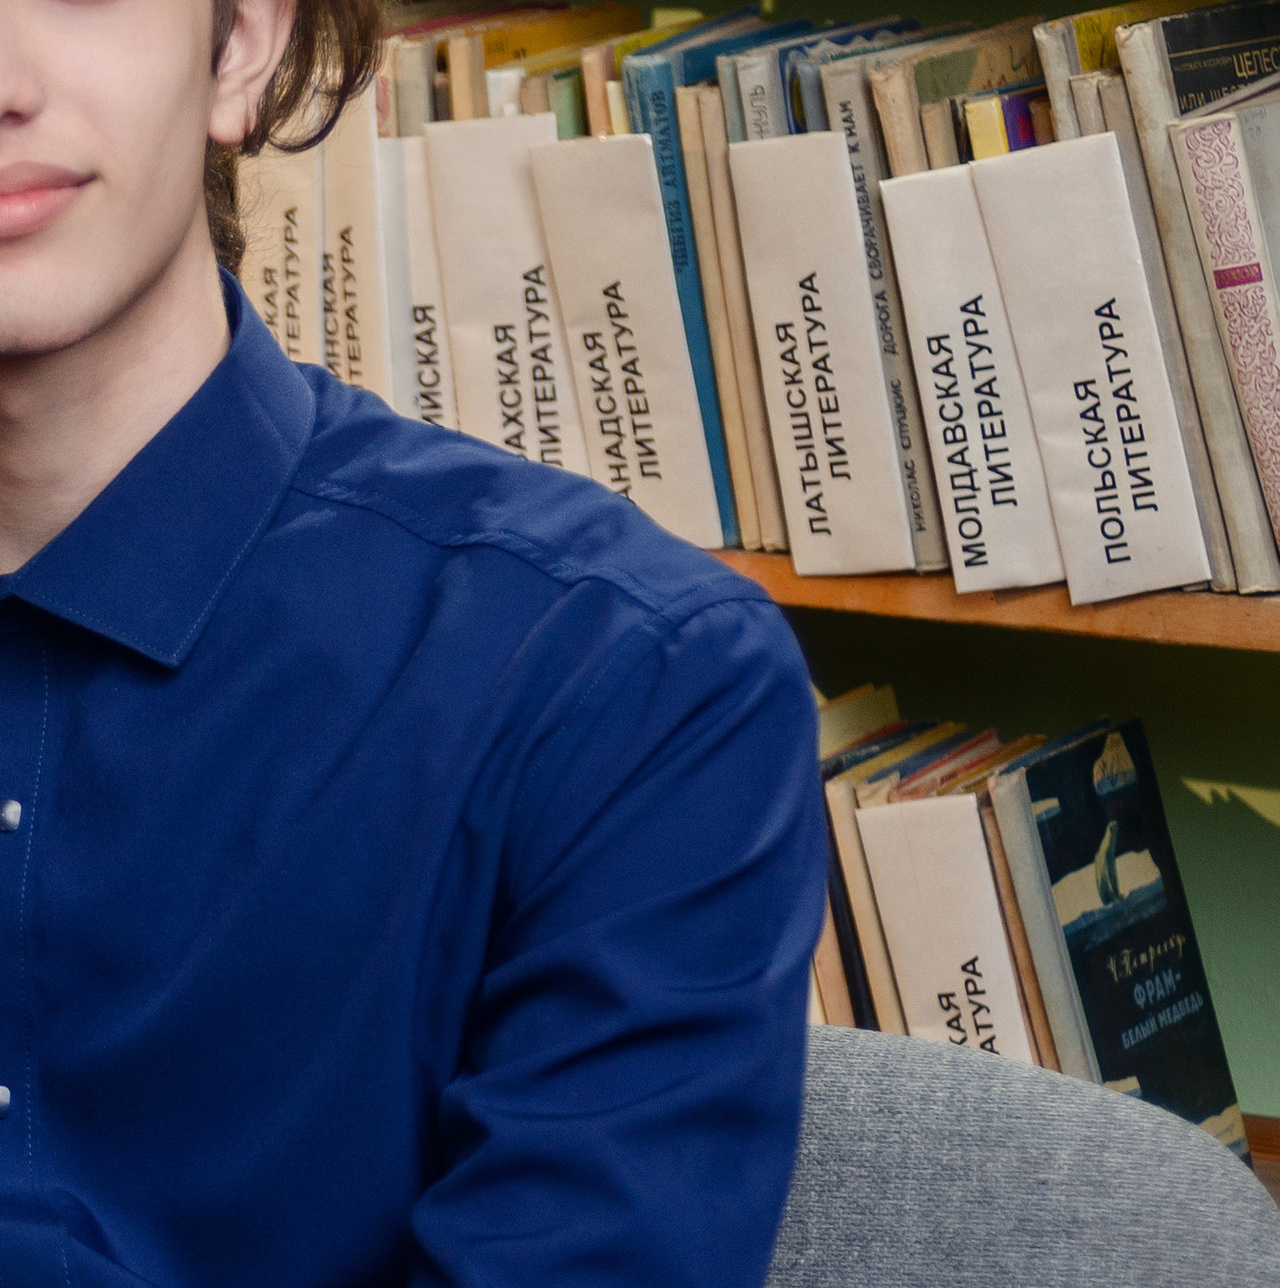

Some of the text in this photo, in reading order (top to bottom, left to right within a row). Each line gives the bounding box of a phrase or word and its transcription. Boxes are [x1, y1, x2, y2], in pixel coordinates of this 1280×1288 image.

[838, 100, 858, 137] НАМ
[847, 142, 861, 154] К
[1179, 94, 1207, 111] ИЛИ
[283, 205, 302, 358] ТЕРАТУРА
[850, 163, 885, 280] СВОРАЧИВАЕТ
[339, 225, 363, 379] ТЕРАТУРА
[522, 264, 564, 467] ЛИТЕРАТУРА
[797, 271, 852, 481] ЛИТЕРАТУРА
[875, 289, 899, 356] ДОРОГА
[493, 323, 527, 459] АХСКАЯ
[602, 281, 662, 480] ЛИТЕРАТУРА
[774, 321, 832, 536] ЛАТЫШСКАЯ
[926, 334, 989, 568] МОЛДАВСКАЯ
[959, 294, 1018, 506] ЛИТЕРАТУРА
[1094, 297, 1158, 512] ЛИТЕРАТУРА
[1073, 378, 1131, 564] ПОЛЬСКАЯ
[961, 955, 1001, 1055] АТУРА
